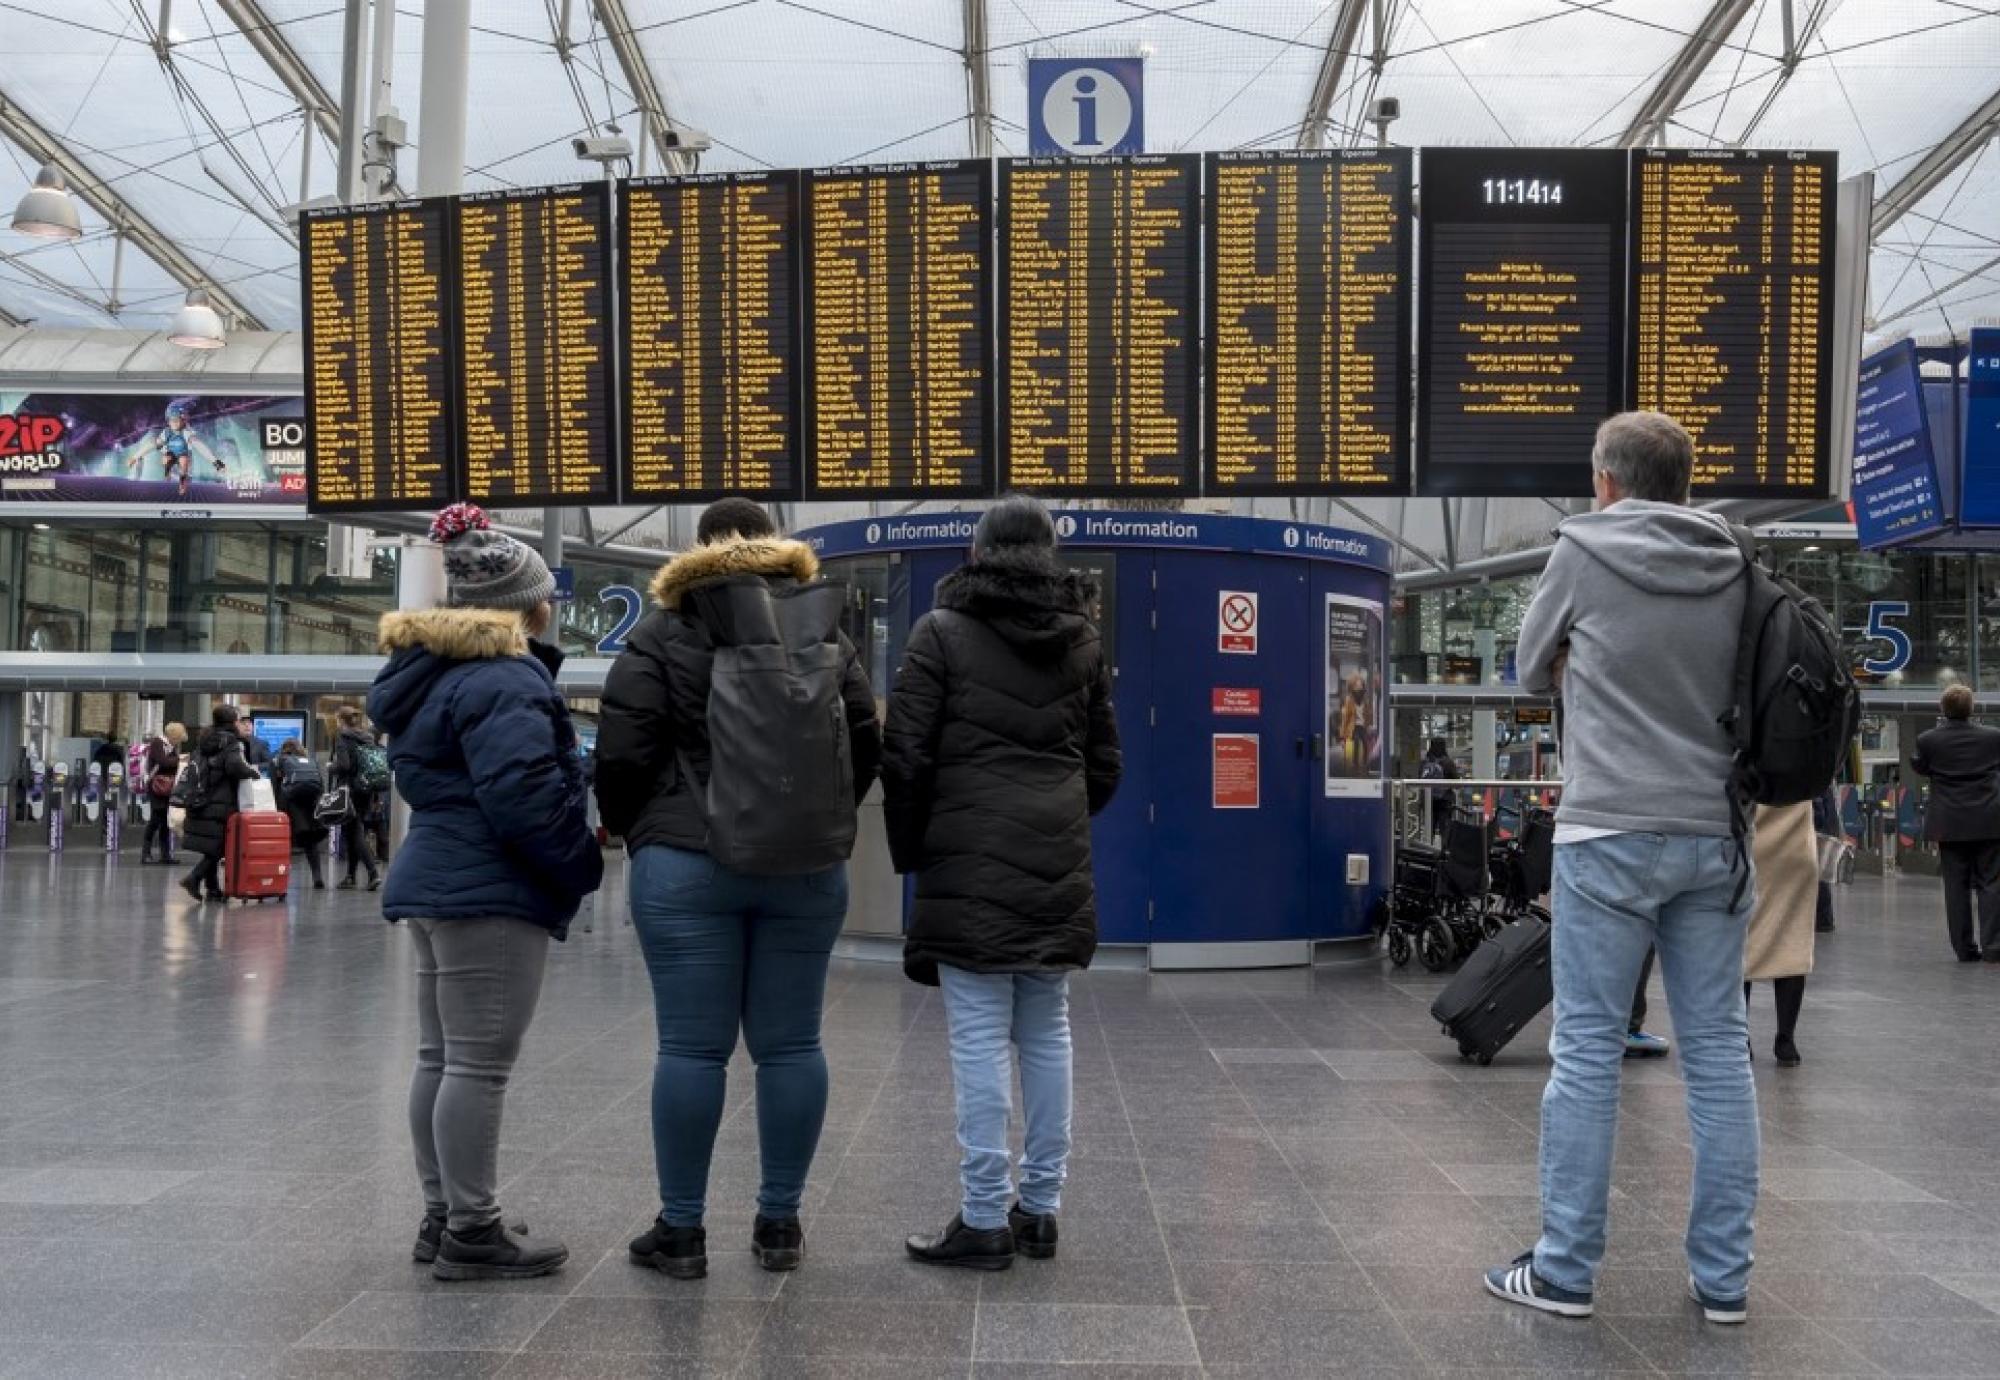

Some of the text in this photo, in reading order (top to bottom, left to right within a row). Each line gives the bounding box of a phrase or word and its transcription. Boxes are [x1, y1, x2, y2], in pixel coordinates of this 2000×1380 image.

[265, 424, 304, 446] BO
[1087, 517, 1198, 539] Information
[1306, 530, 1368, 556] Information
[596, 584, 642, 655] 2
[1863, 601, 1912, 674] 5
